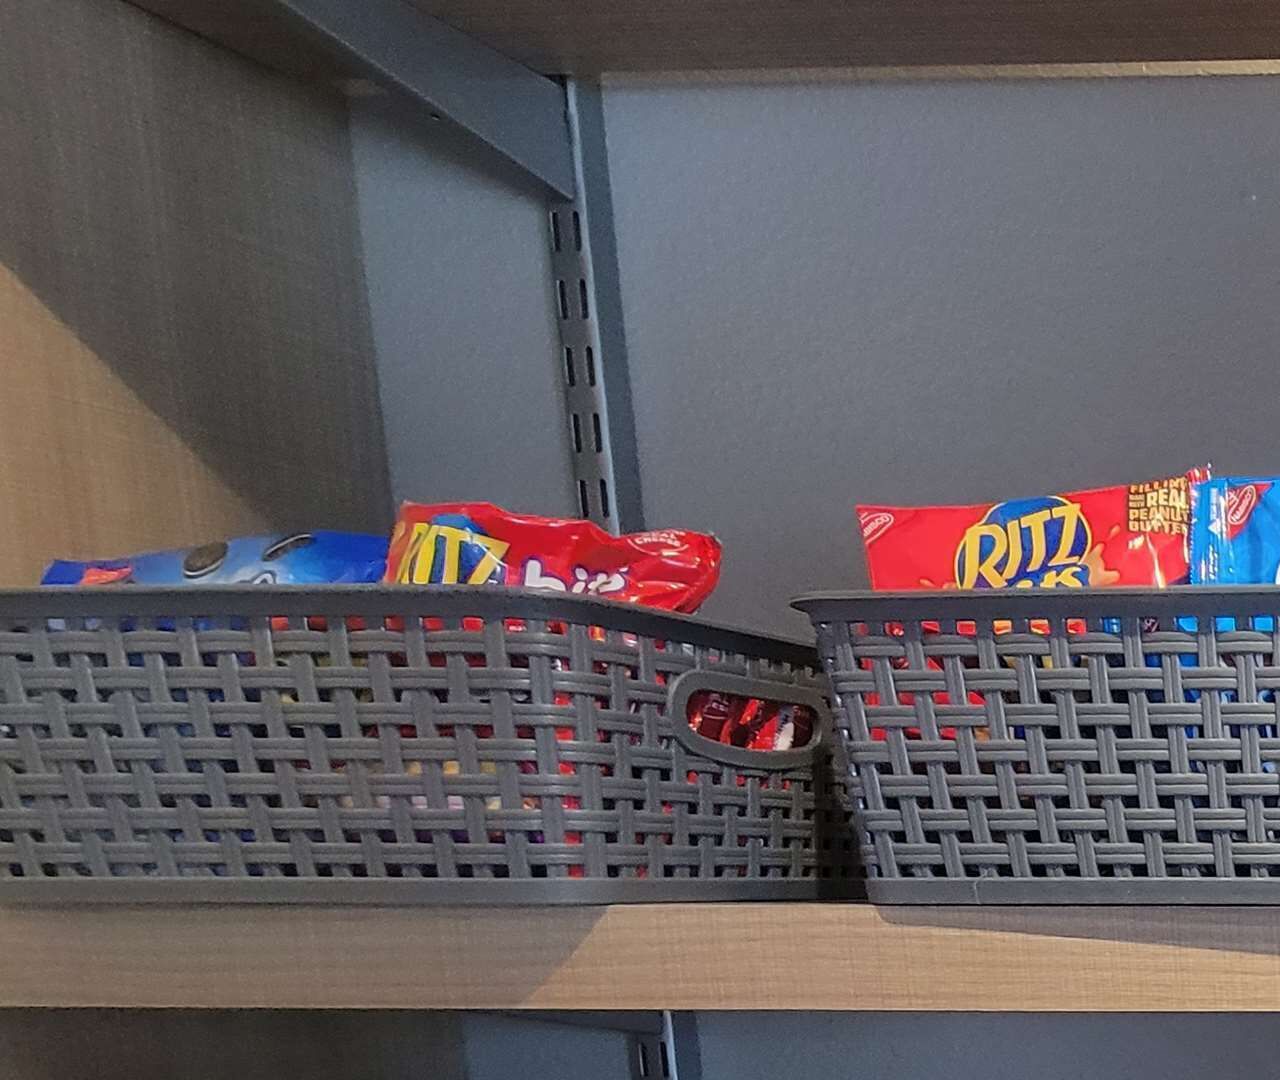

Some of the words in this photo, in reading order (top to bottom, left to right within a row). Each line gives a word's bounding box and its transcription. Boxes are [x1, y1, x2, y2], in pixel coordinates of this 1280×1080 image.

[1146, 489, 1187, 508] REAL
[1129, 506, 1188, 523] PEANUT
[957, 503, 1082, 589] RITZ
